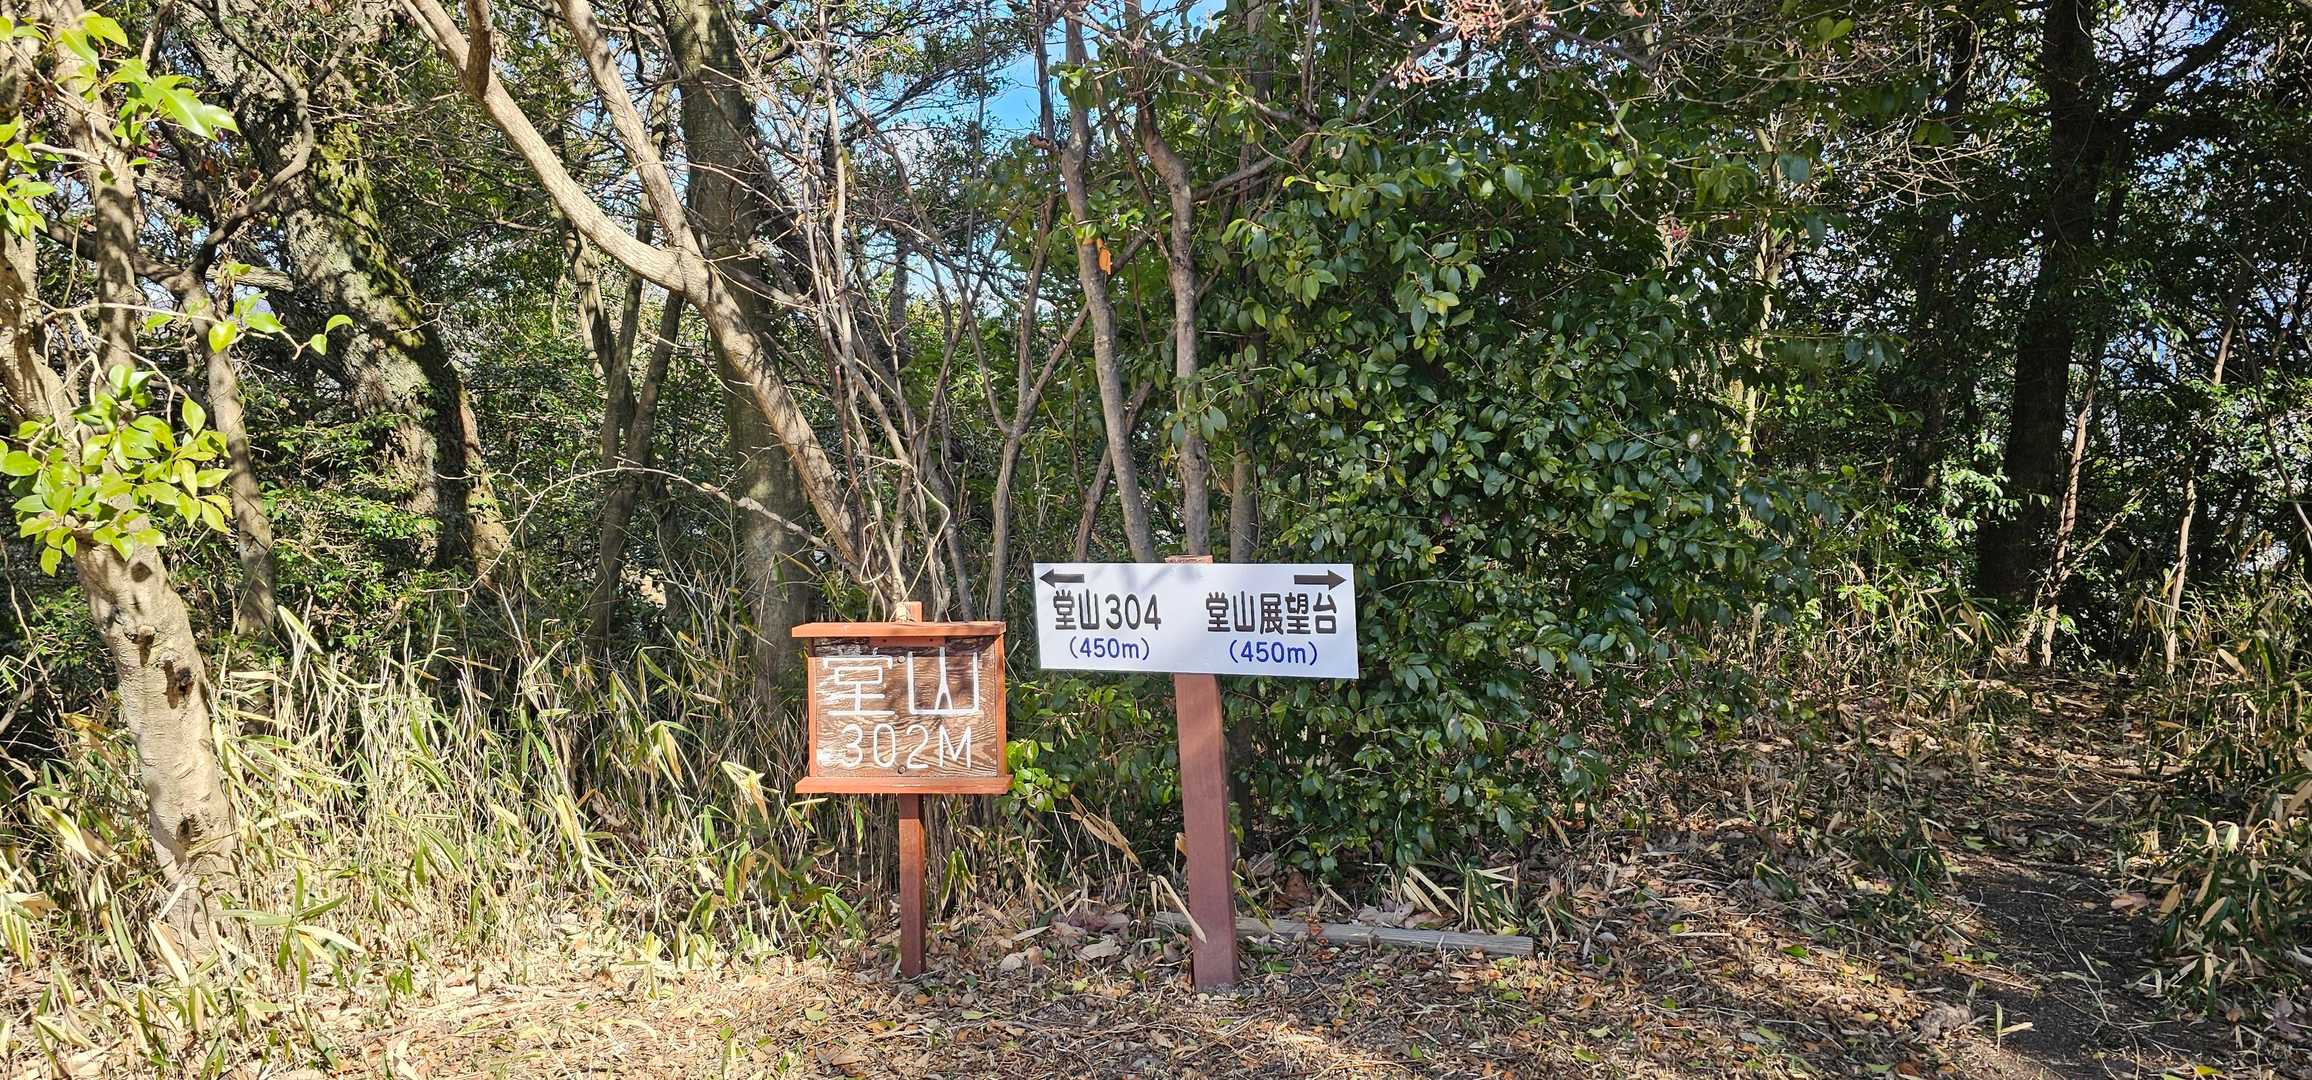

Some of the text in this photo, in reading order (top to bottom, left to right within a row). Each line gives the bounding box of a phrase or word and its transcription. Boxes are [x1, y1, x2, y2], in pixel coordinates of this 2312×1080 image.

[1052, 588, 1162, 631] 堂山304
[1205, 590, 1338, 636] 堂山展望台
[1069, 636, 1150, 661] (450m)
[1229, 639, 1318, 666] (450m)
[822, 647, 980, 716] 堂山
[841, 723, 972, 769] 302M
